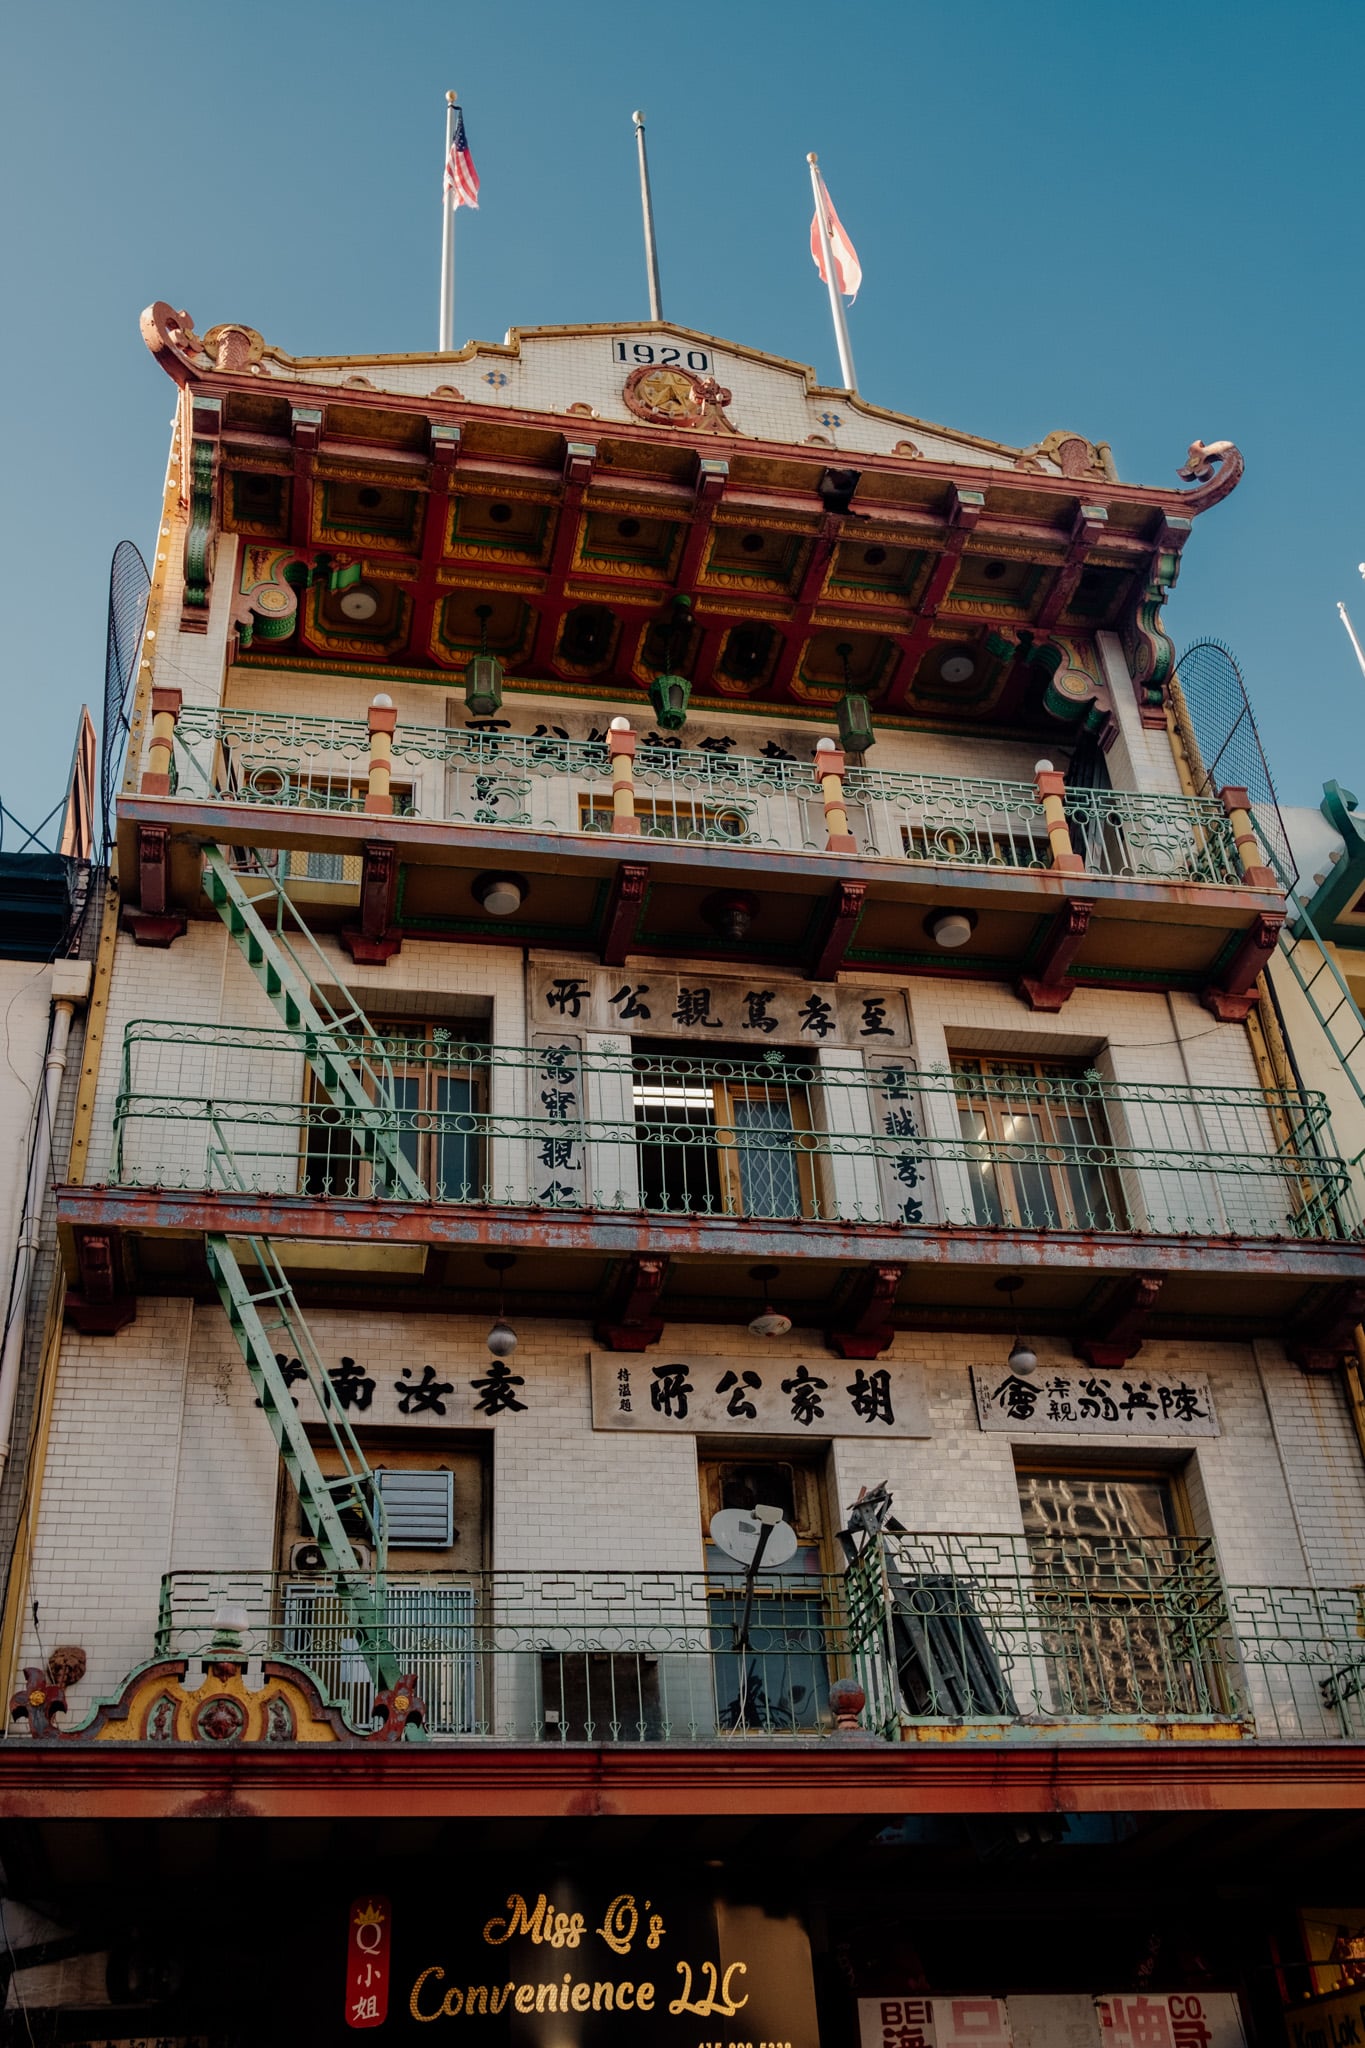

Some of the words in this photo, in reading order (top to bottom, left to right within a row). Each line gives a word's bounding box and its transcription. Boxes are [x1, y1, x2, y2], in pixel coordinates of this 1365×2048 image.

[616, 342, 709, 372] 1920
[650, 1363, 895, 1427] 胡家公所
[482, 1893, 588, 1949] Miss
[596, 1893, 668, 1956] Q's
[409, 1965, 656, 2024] Convenience
[669, 1960, 750, 2018] LLC
[1168, 1995, 1207, 2020] CO.
